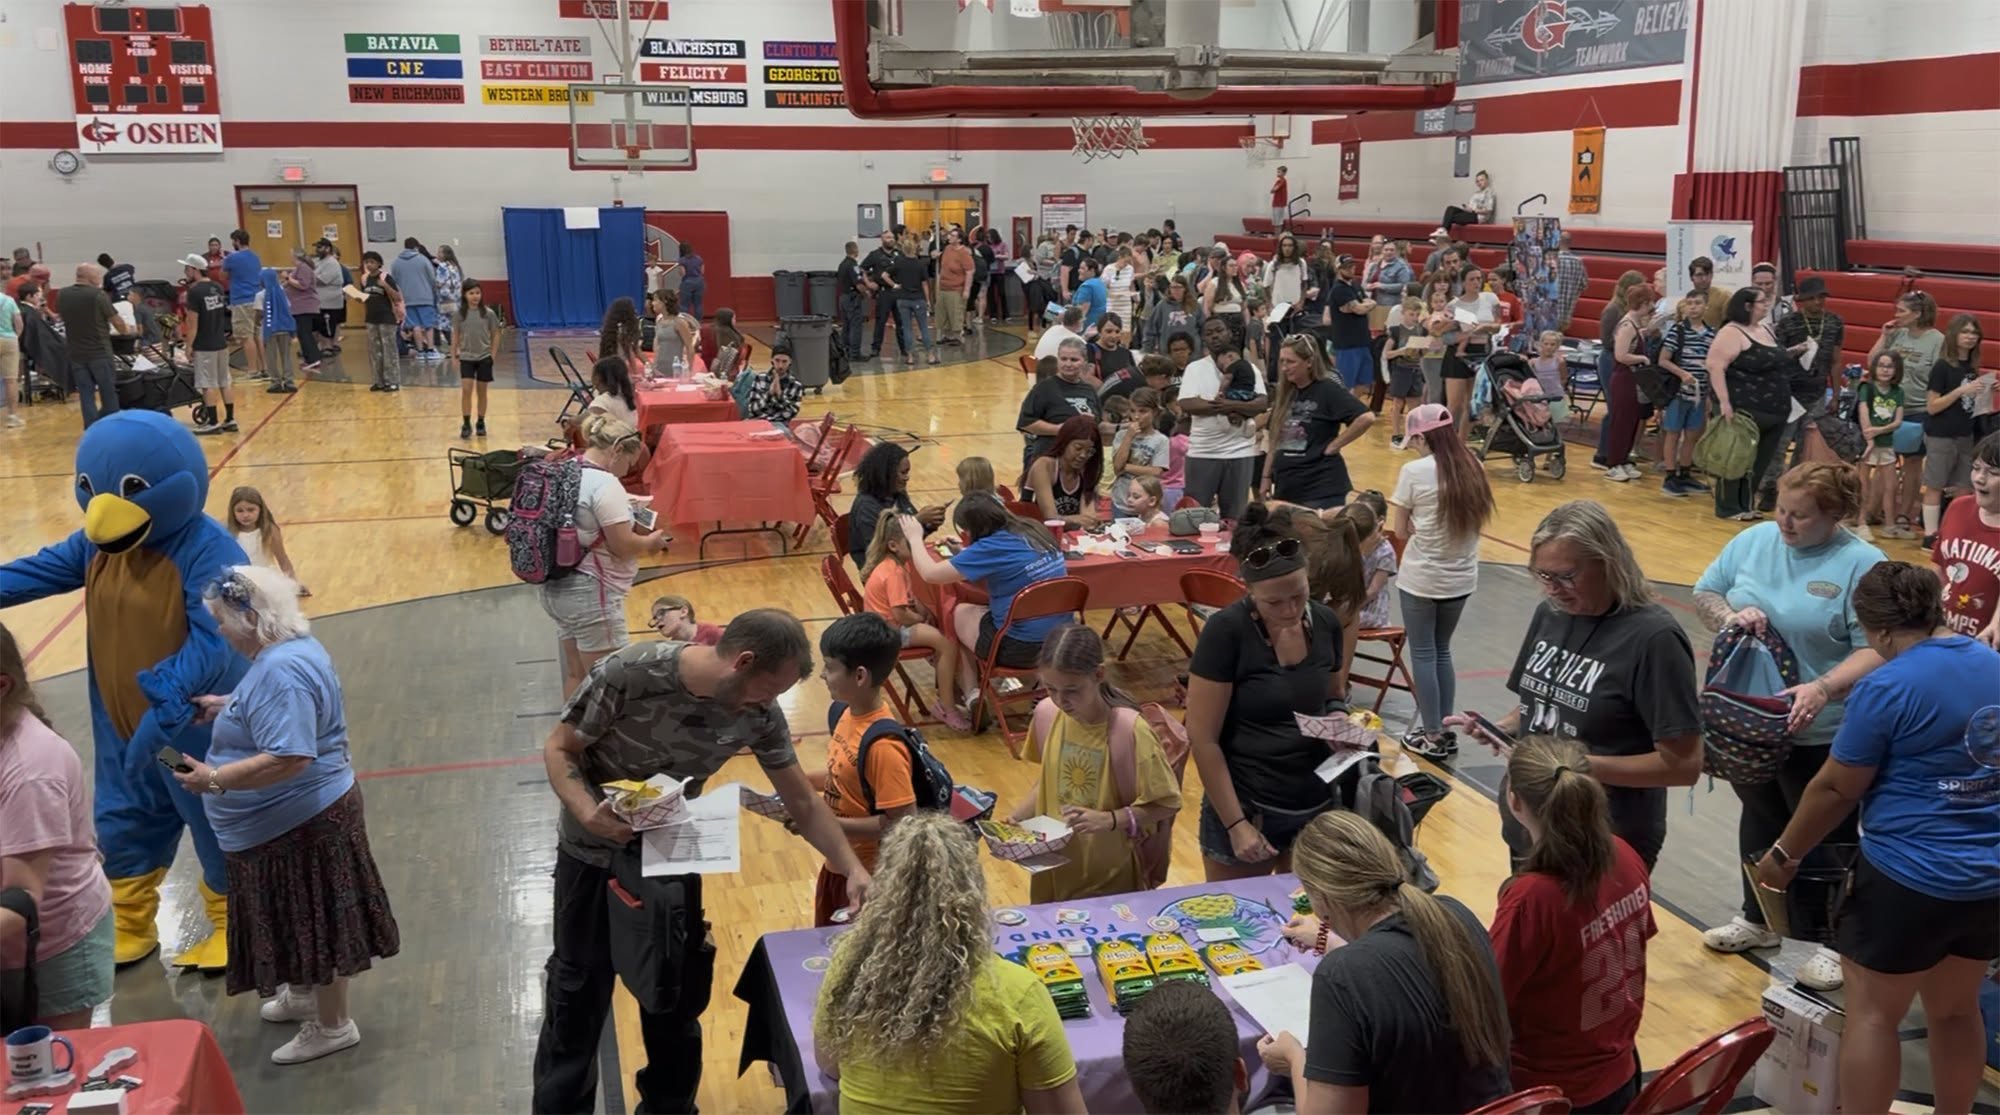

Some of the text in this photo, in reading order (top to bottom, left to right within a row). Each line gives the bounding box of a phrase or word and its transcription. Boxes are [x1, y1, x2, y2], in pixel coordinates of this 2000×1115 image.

[367, 37, 439, 50] BATAVIA
[489, 38, 581, 52] BETHEL-TATE
[650, 40, 738, 55] BLANCHESTER
[127, 48, 157, 56] PERIOD
[766, 45, 816, 57] CLINTON
[1575, 41, 1629, 66] TEAMWORK
[79, 64, 112, 74] HOME
[169, 65, 213, 75] VISITOR
[386, 62, 424, 75] CNE
[485, 64, 589, 78] EAST CLINTON
[659, 66, 728, 80] FELICITY
[180, 77, 205, 85] FOULS
[354, 87, 461, 100] NEW RICHMOND
[487, 88, 543, 101] WESTERN
[1424, 120, 1444, 132] FANS
[993, 923, 1118, 945] FOUND
